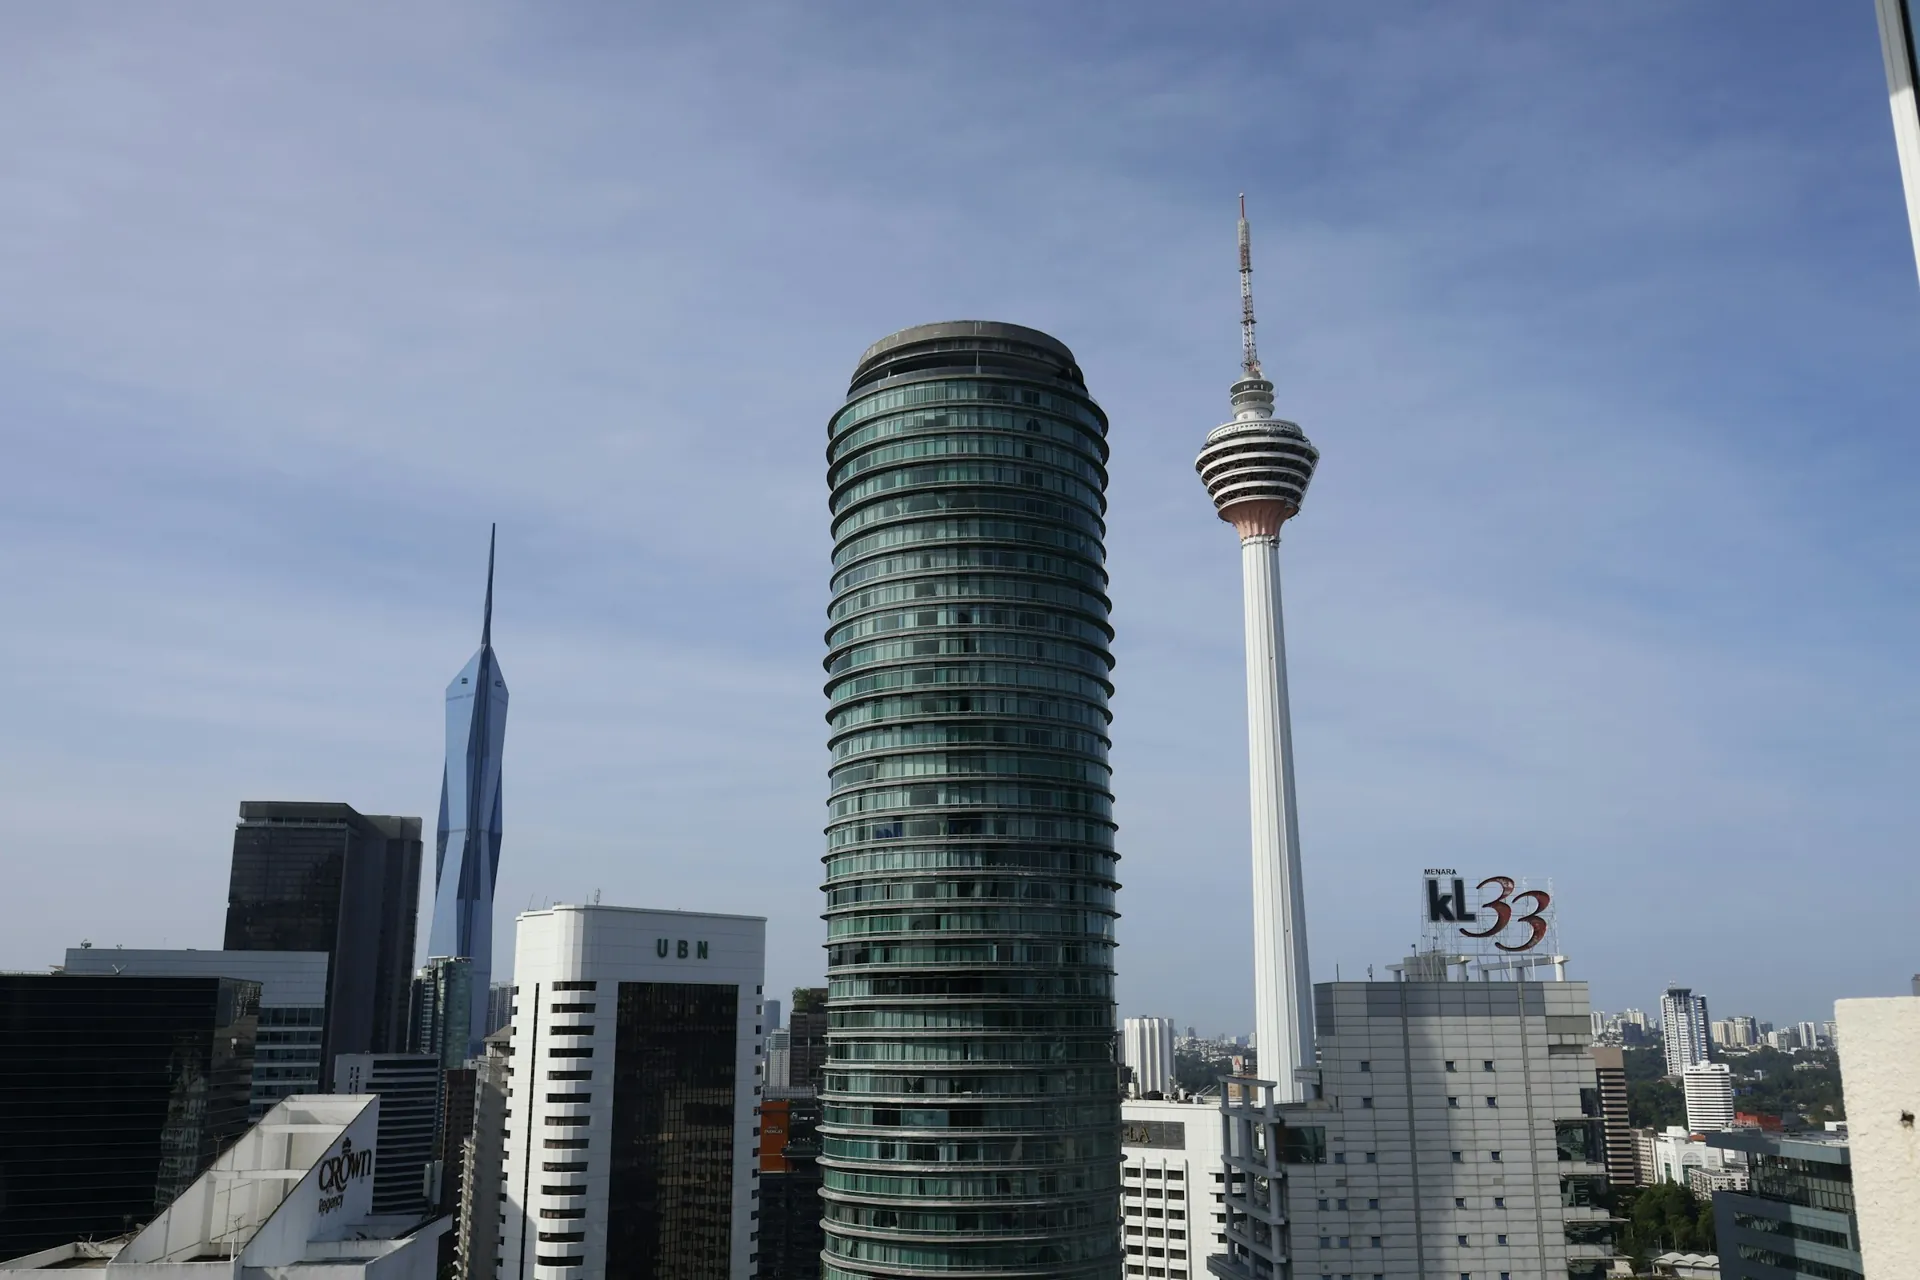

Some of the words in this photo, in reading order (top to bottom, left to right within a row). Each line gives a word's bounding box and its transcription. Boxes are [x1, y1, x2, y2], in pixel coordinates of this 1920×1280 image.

[1424, 868, 1457, 876] MENARA
[657, 938, 708, 960] UBN
[318, 1195, 344, 1214] Regency
